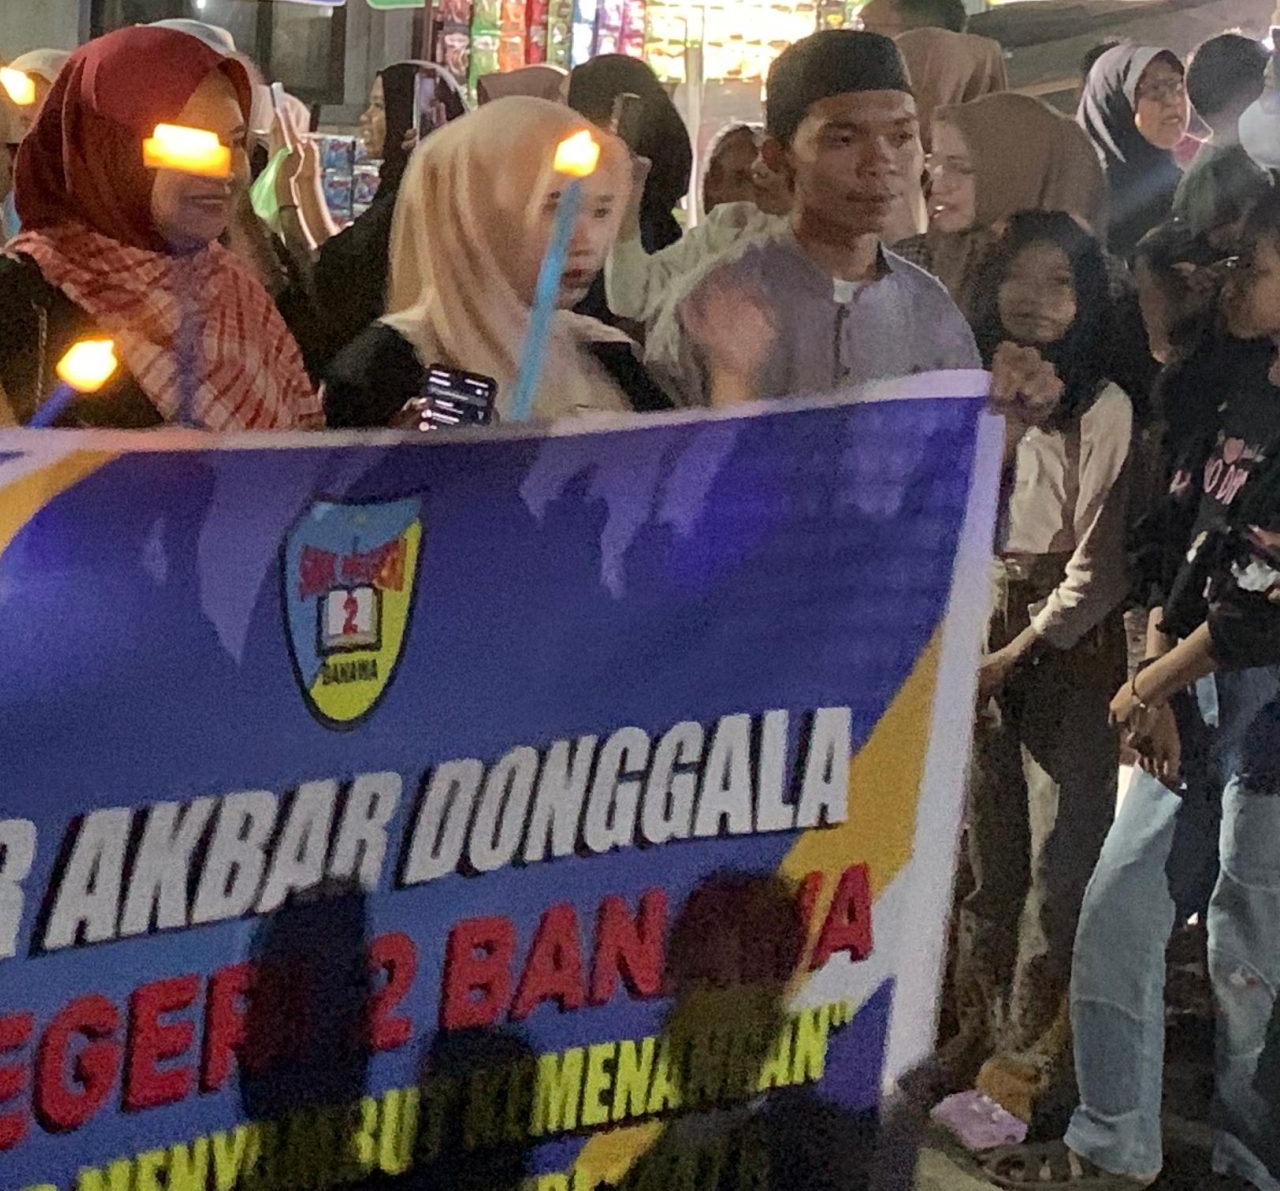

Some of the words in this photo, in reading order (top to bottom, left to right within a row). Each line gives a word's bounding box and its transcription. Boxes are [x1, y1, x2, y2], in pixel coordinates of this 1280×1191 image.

[341, 593, 360, 635] 2
[38, 771, 402, 951] AKBAR
[402, 705, 853, 886] DONGGALA
[356, 929, 419, 1054] 2
[438, 861, 875, 1031] BANA
